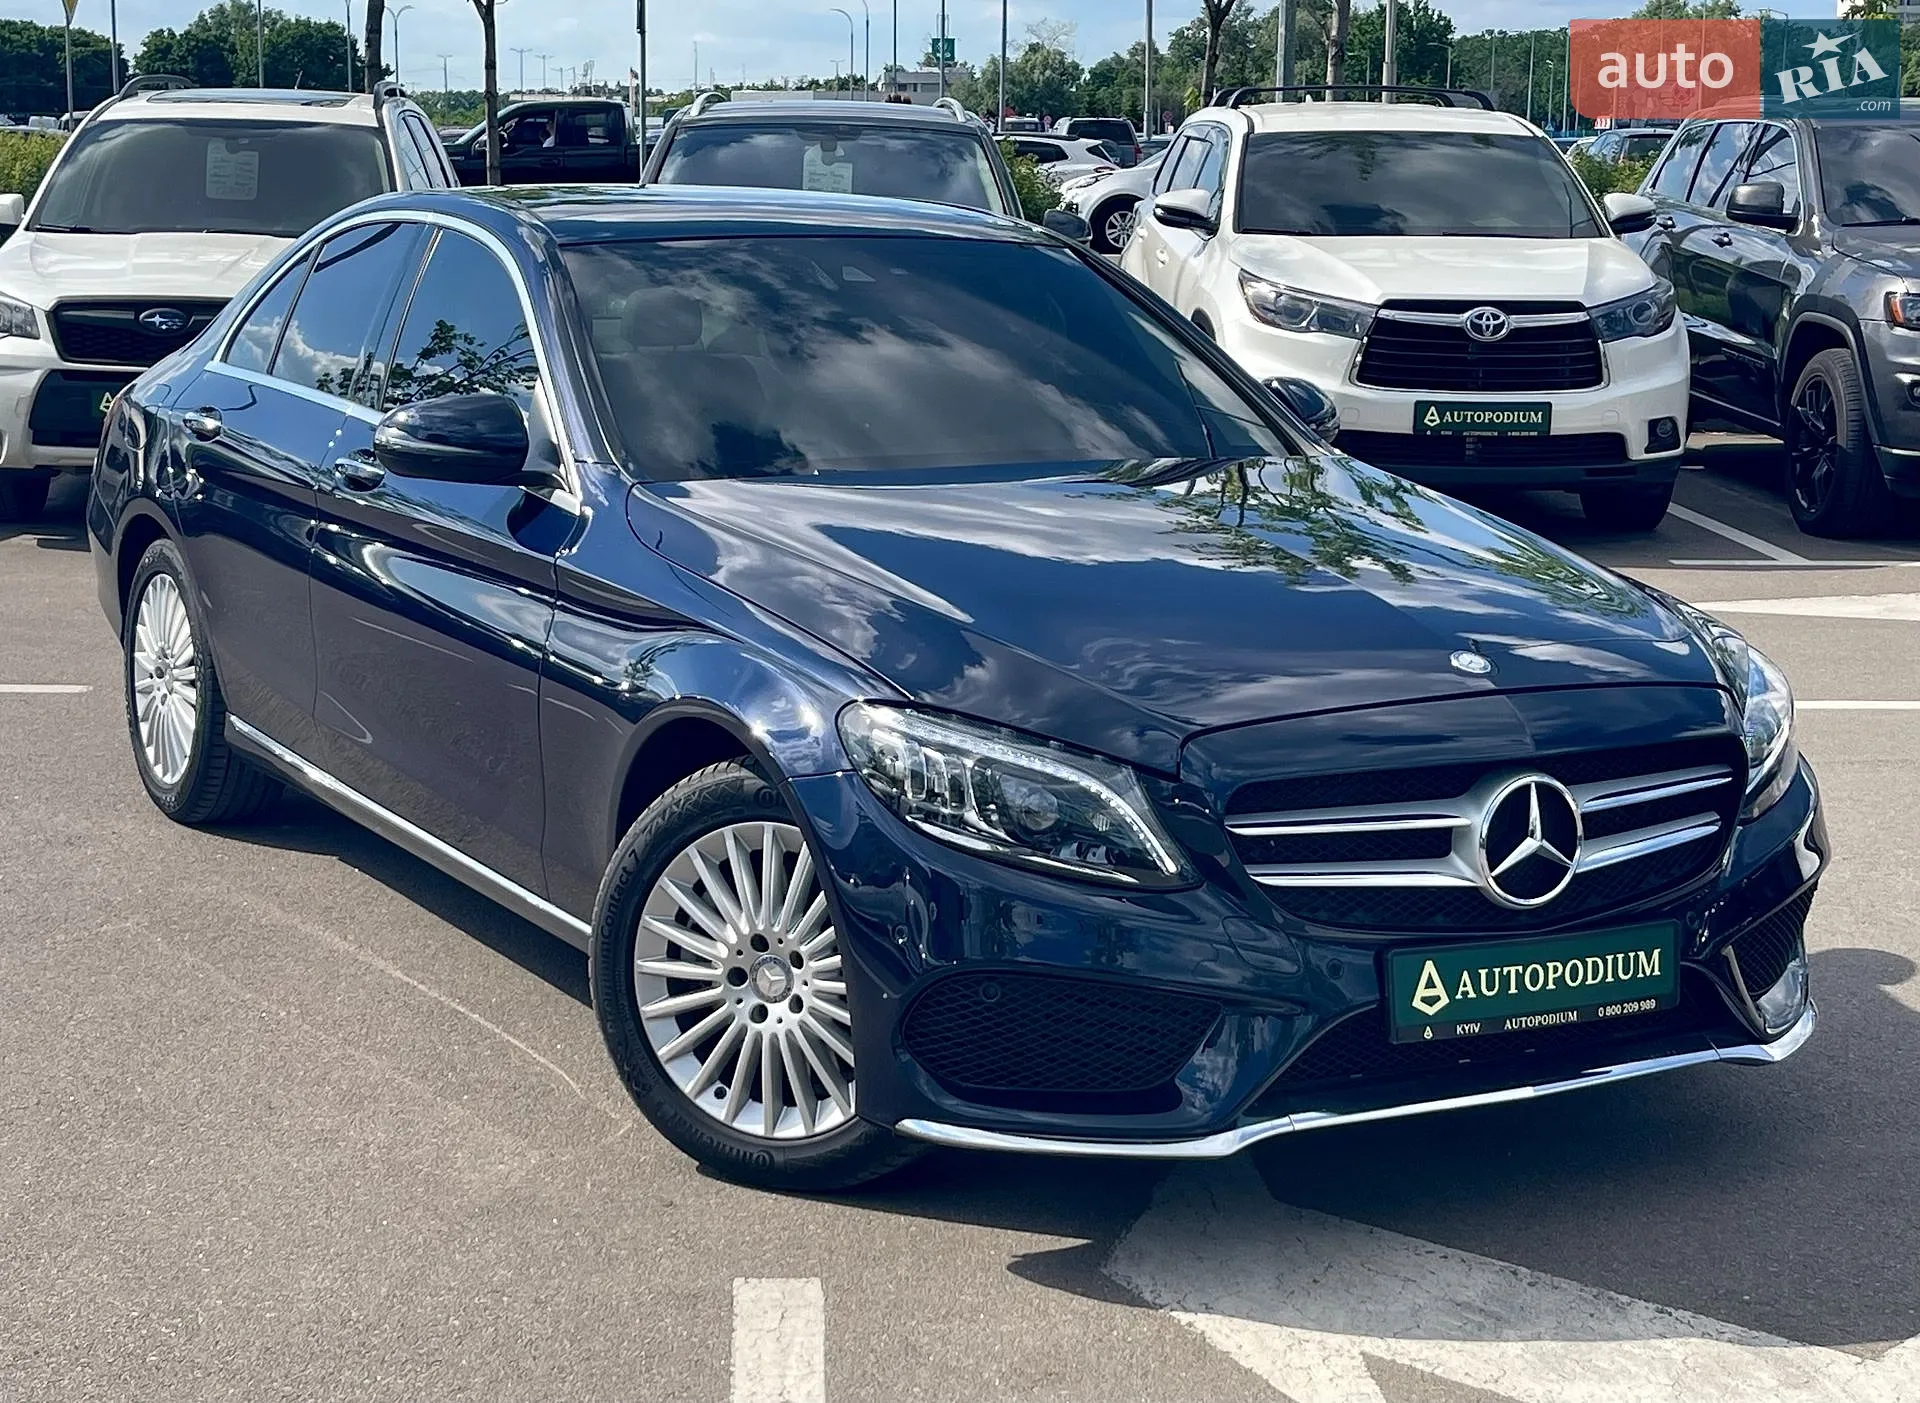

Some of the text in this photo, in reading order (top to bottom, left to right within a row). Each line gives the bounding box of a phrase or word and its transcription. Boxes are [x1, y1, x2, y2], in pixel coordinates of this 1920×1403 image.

[1443, 411, 1543, 423] AUTOPODIUM
[1455, 948, 1661, 1000] AUTOPODIUM
[1456, 1022, 1481, 1035] KYIV
[1504, 1011, 1578, 1031] AUTOPODIUM
[1598, 1007, 1604, 1017] 0
[1605, 1004, 1622, 1016] 800
[1622, 1001, 1639, 1013] 209
